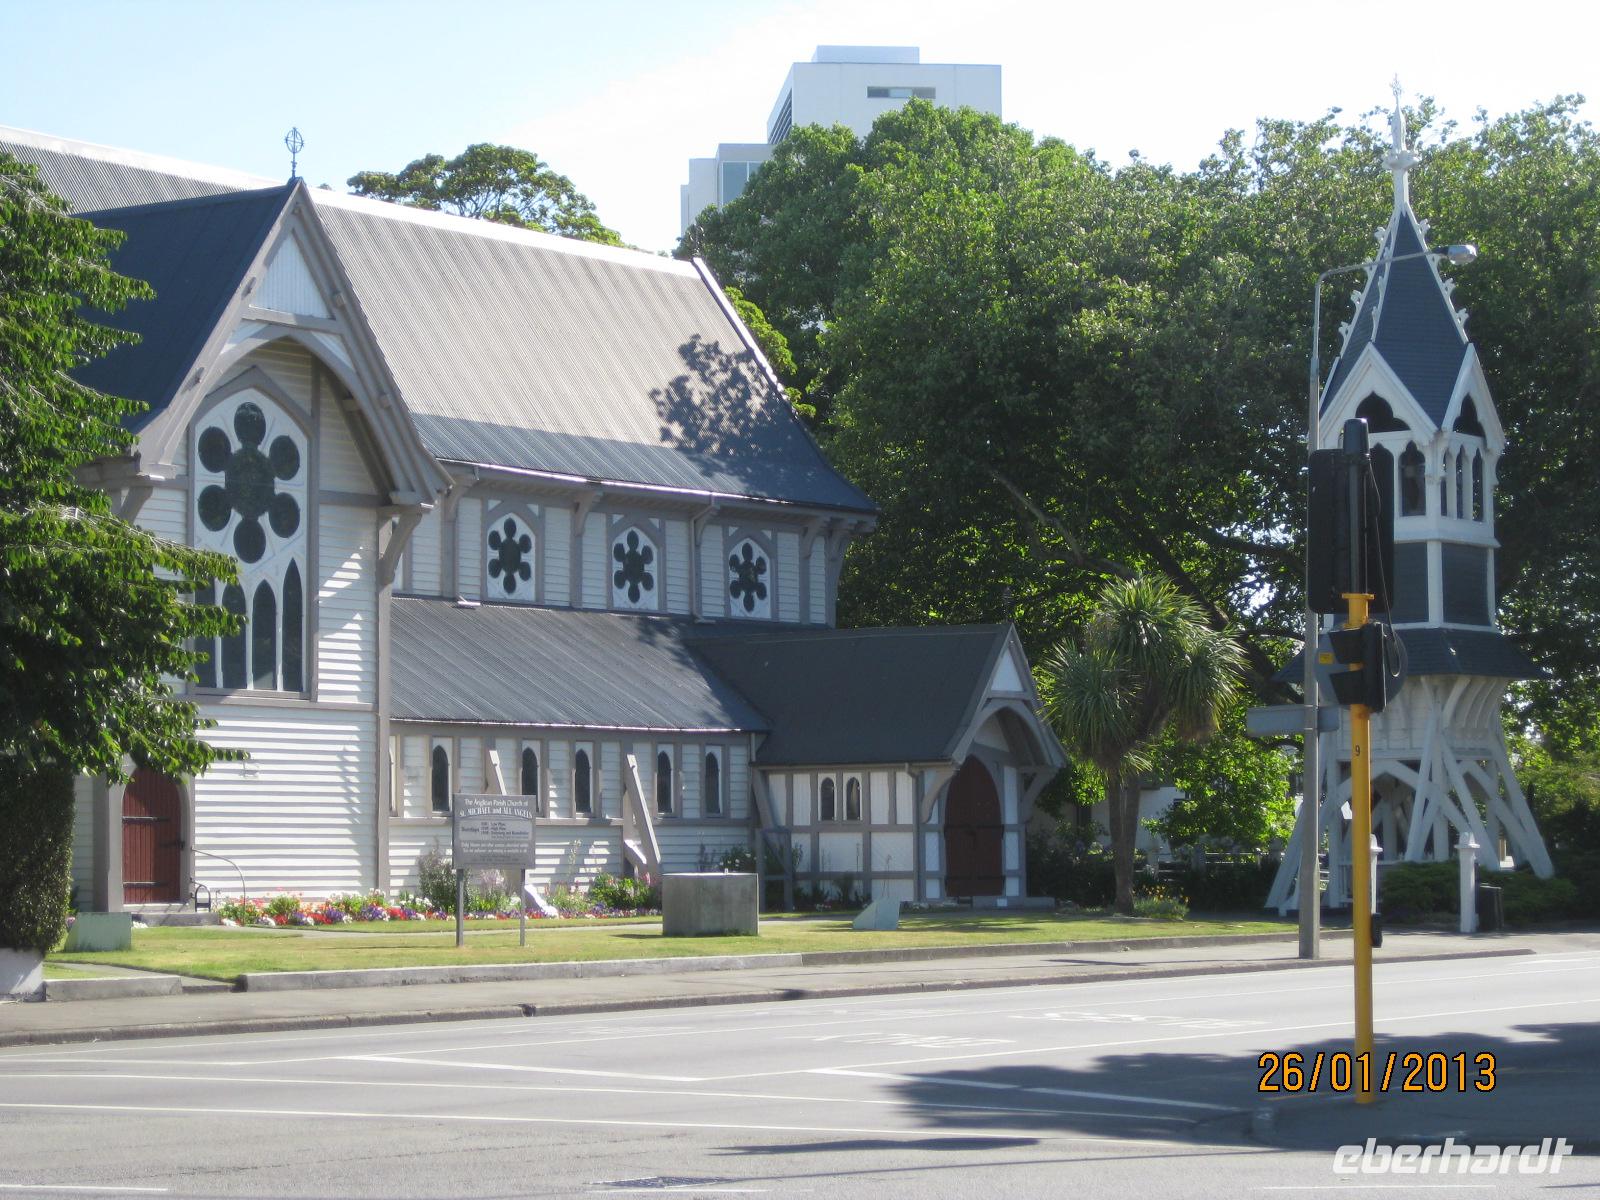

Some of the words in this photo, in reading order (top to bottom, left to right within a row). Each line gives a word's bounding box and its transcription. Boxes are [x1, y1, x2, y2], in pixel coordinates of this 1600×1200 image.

[474, 798, 492, 807] Anglican
[493, 799, 507, 807] Parish
[468, 806, 490, 816] MICHAEL
[492, 807, 502, 815] and
[503, 807, 512, 815] ALL
[514, 808, 533, 819] ANGELS
